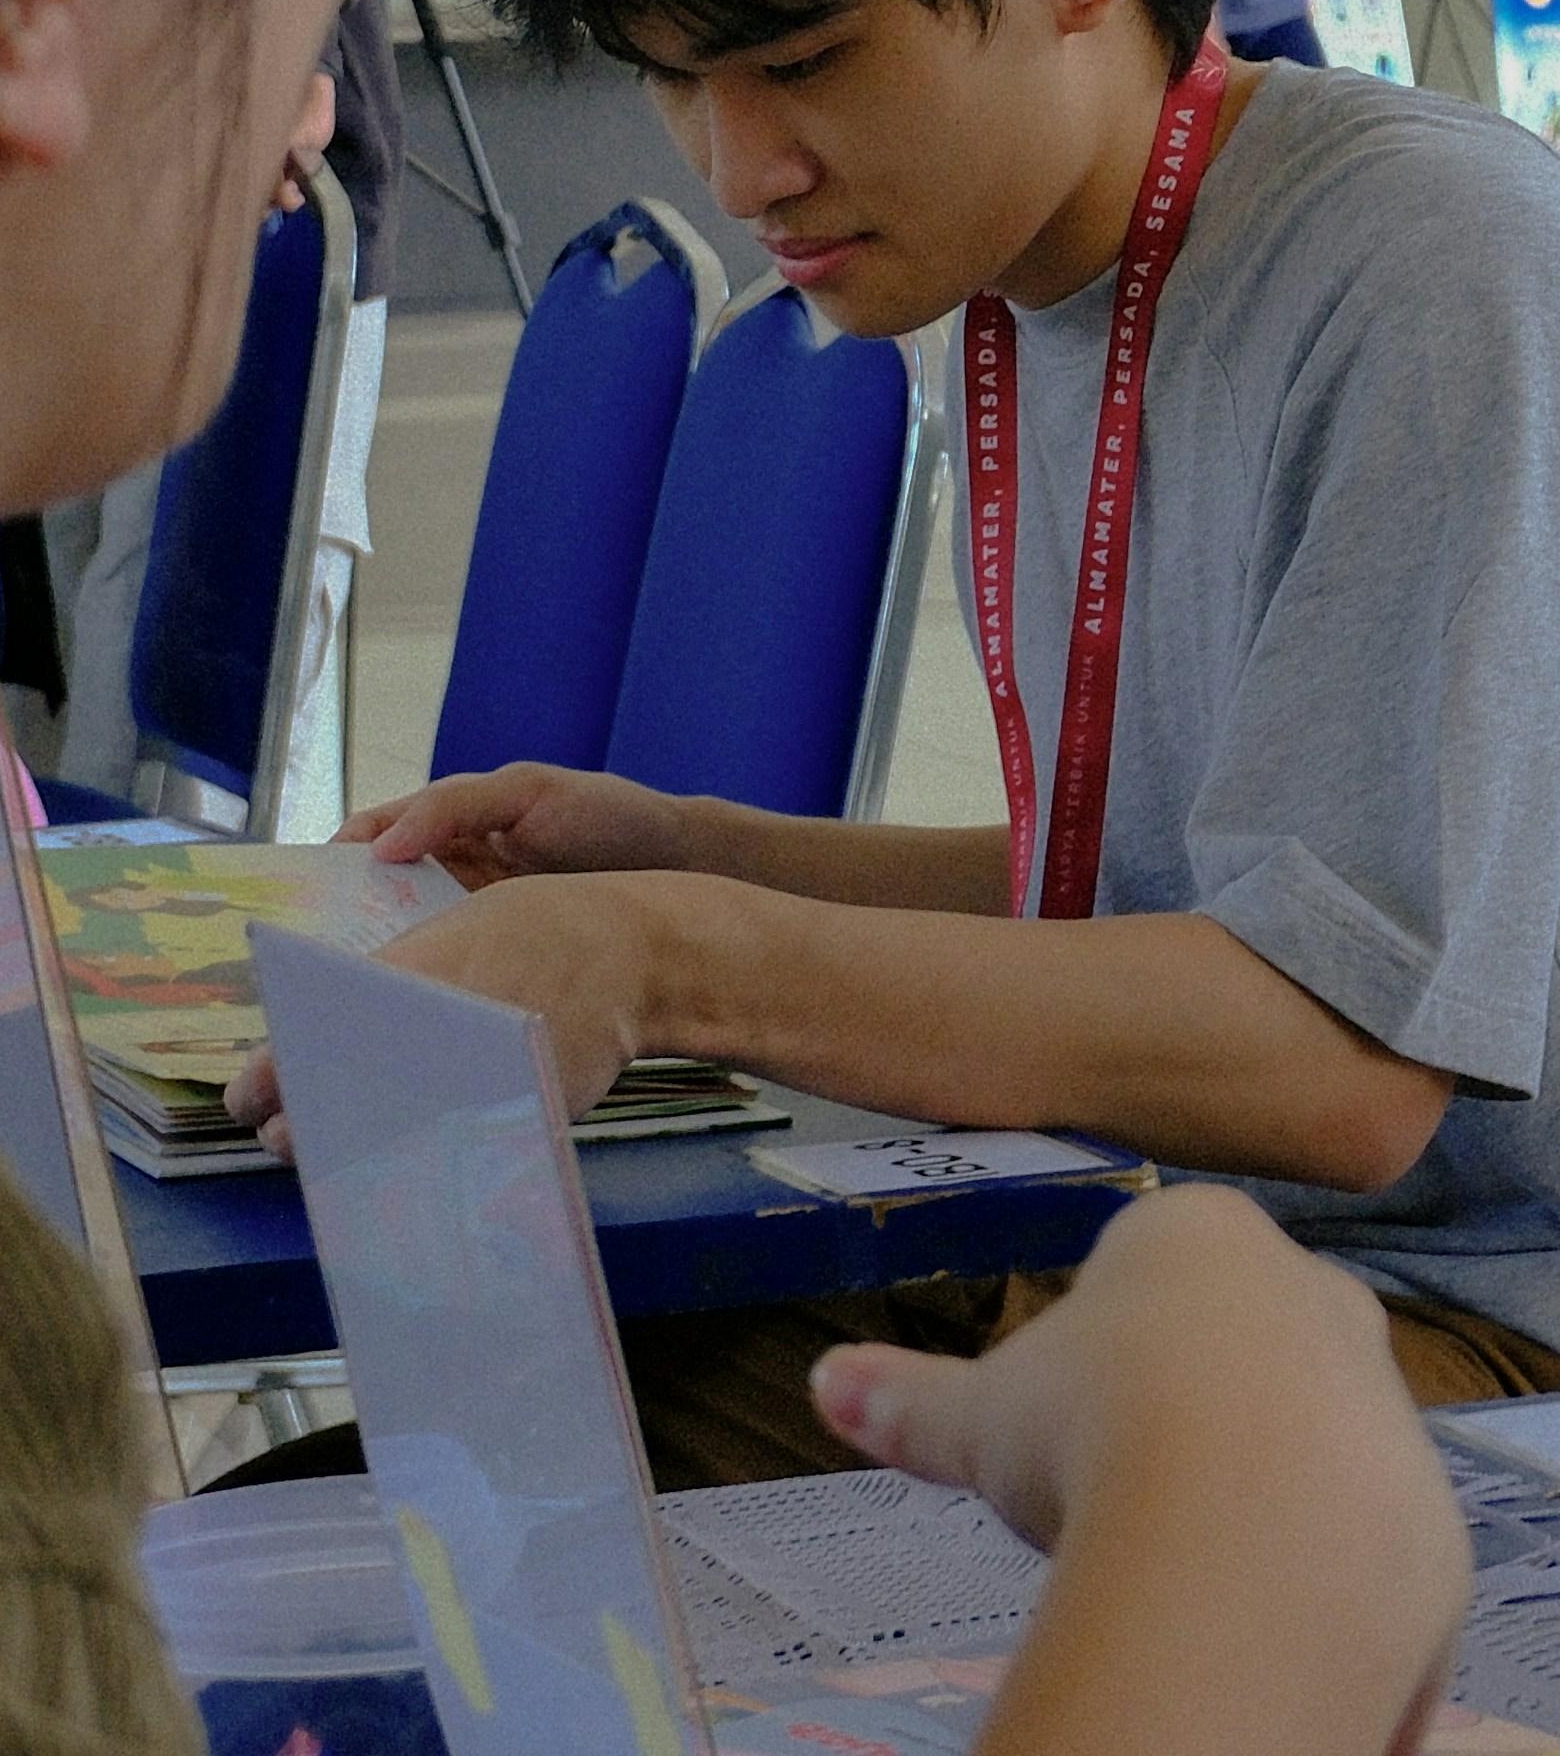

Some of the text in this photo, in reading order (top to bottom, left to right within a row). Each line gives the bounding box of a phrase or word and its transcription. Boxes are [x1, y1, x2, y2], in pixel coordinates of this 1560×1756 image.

[1145, 107, 1196, 233] SESAMA
[978, 317, 999, 472] PERSADA,
[1113, 249, 1159, 405] PERSADA,
[981, 489, 1008, 698] ALMAMATER,
[1084, 424, 1126, 636] ALMAMATER,
[1007, 717, 1022, 786] UNTUK
[1077, 654, 1095, 723] UNTUK
[1066, 734, 1088, 817] TERBAIK
